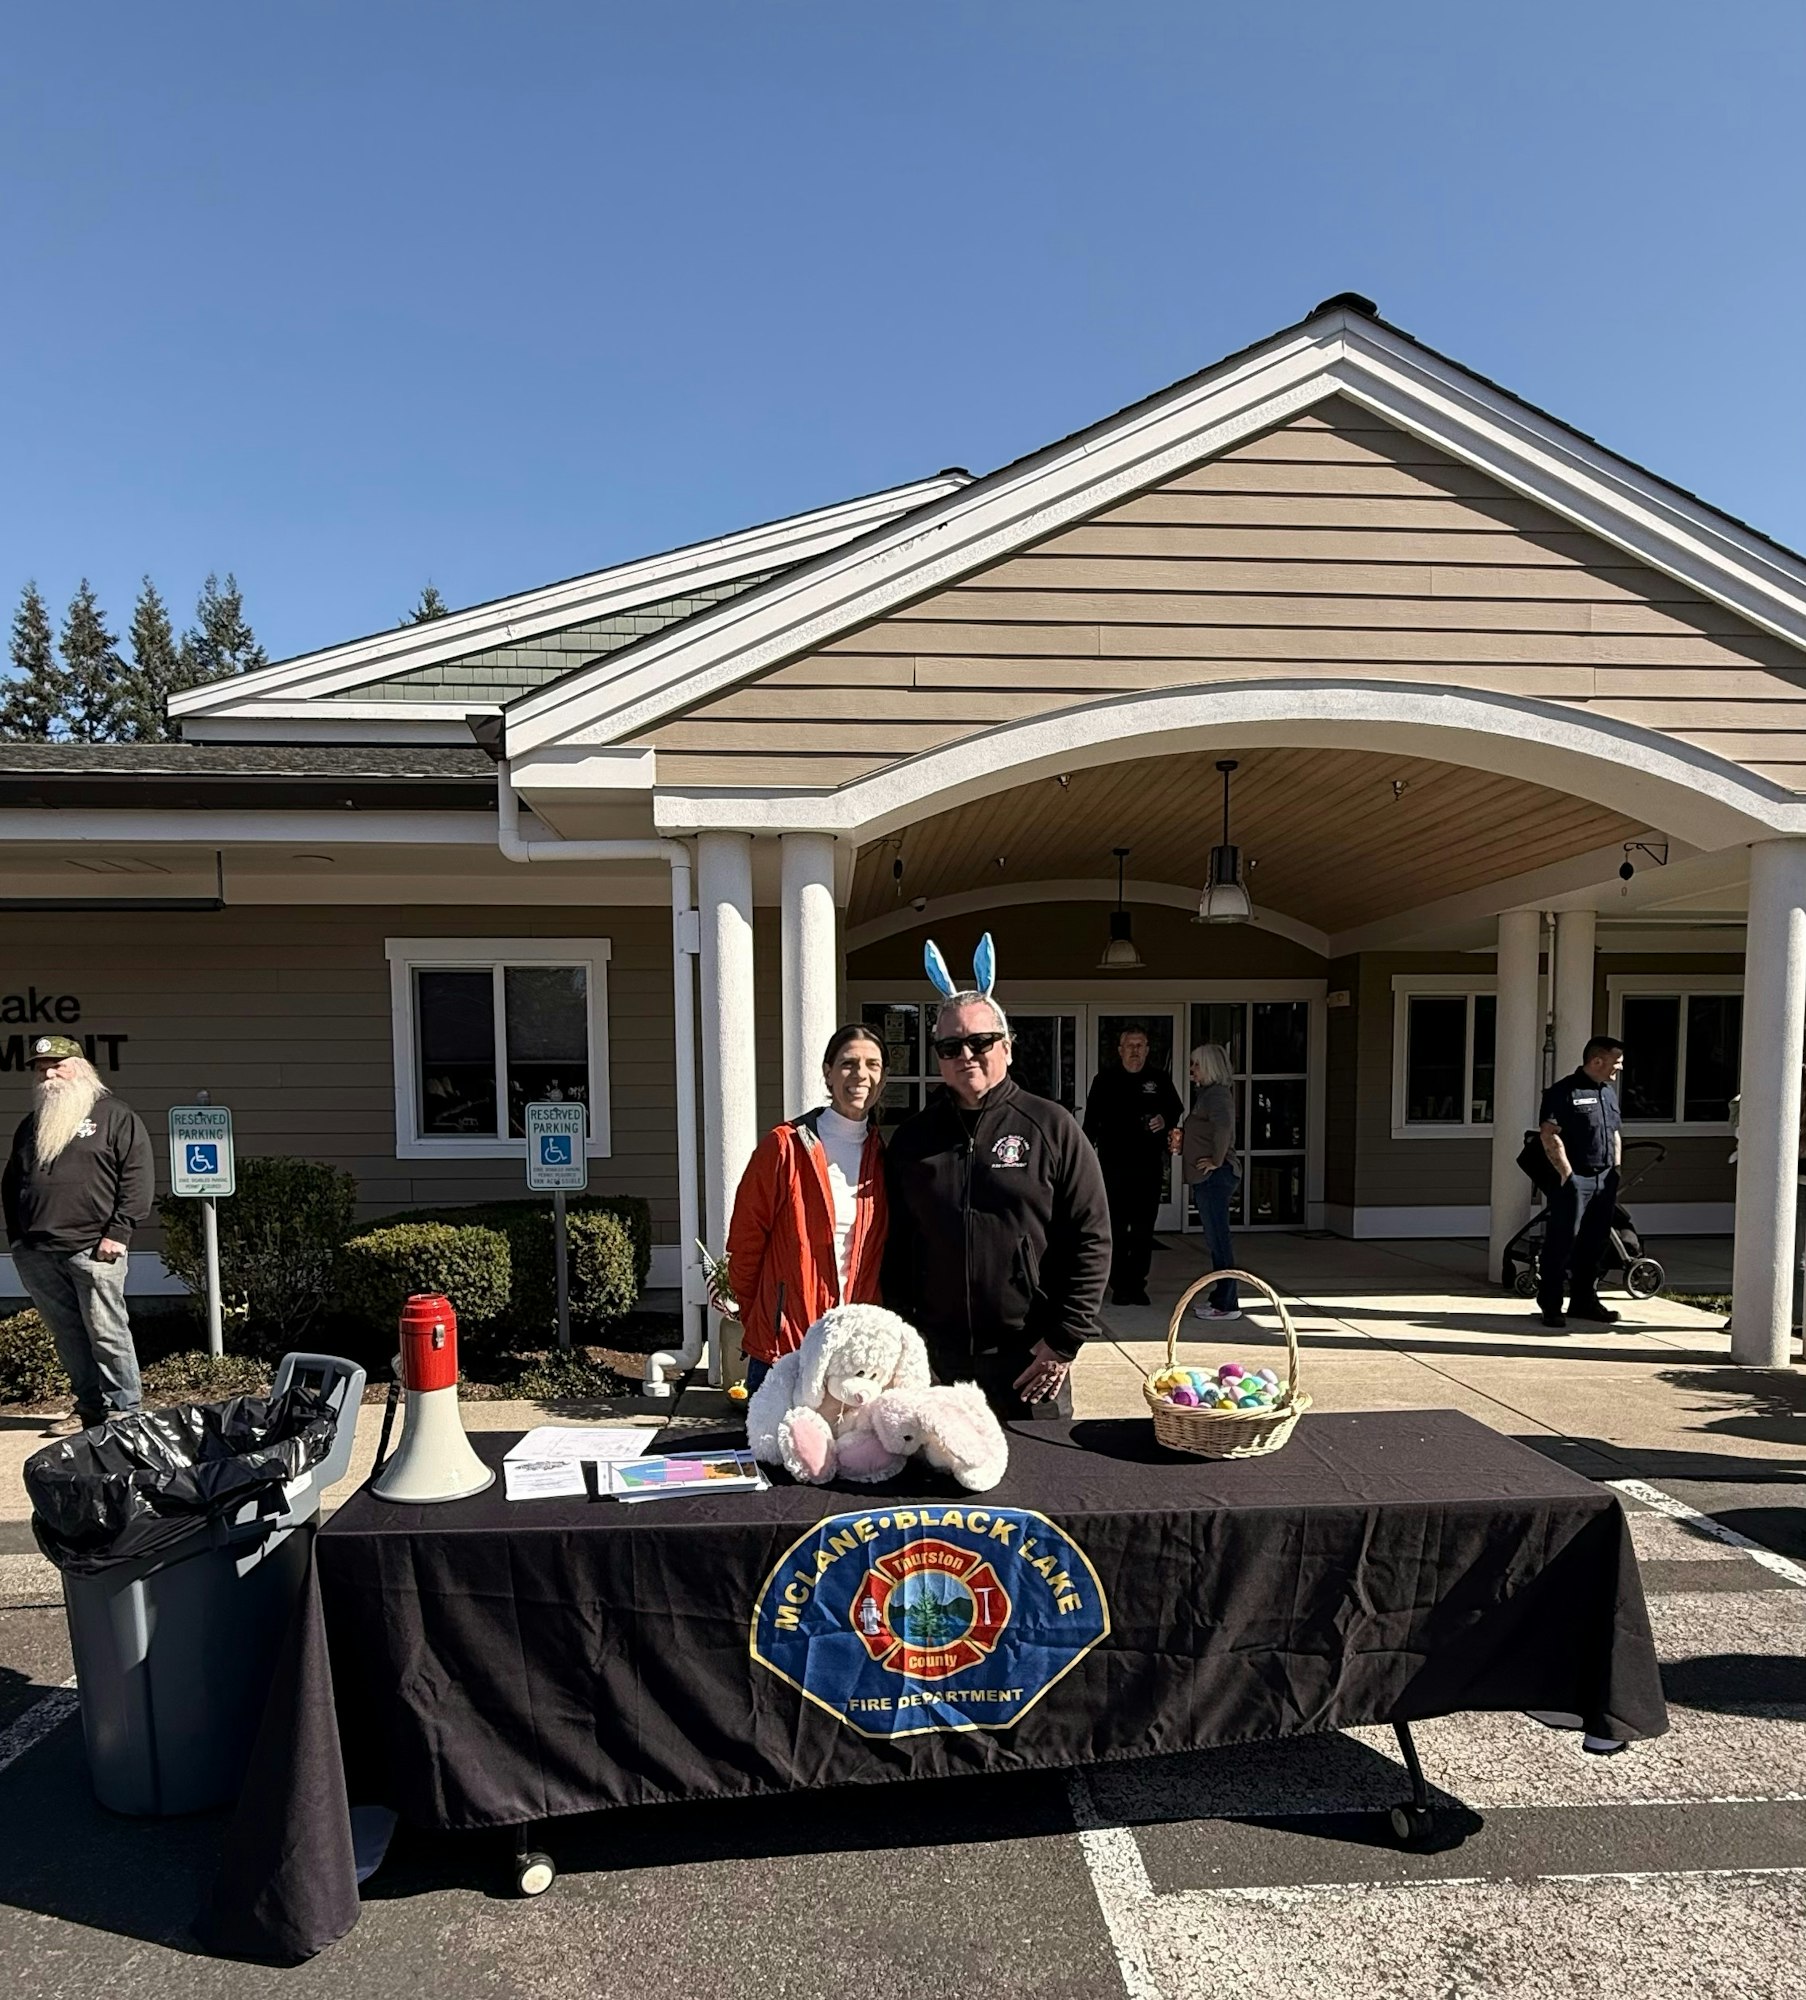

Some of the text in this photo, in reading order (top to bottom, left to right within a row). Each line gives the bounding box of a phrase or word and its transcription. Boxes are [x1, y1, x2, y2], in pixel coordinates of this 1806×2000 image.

[0, 986, 80, 1024] ake
[174, 1114, 226, 1125] RESERVED
[531, 1109, 580, 1121] RESERVED
[178, 1129, 223, 1140] PARKING
[533, 1123, 579, 1134] PARKING
[892, 1551, 964, 1573] Thurston
[1017, 1537, 1083, 1616] LAKE
[850, 1688, 1024, 1712] FIRE DEPARTMENT
